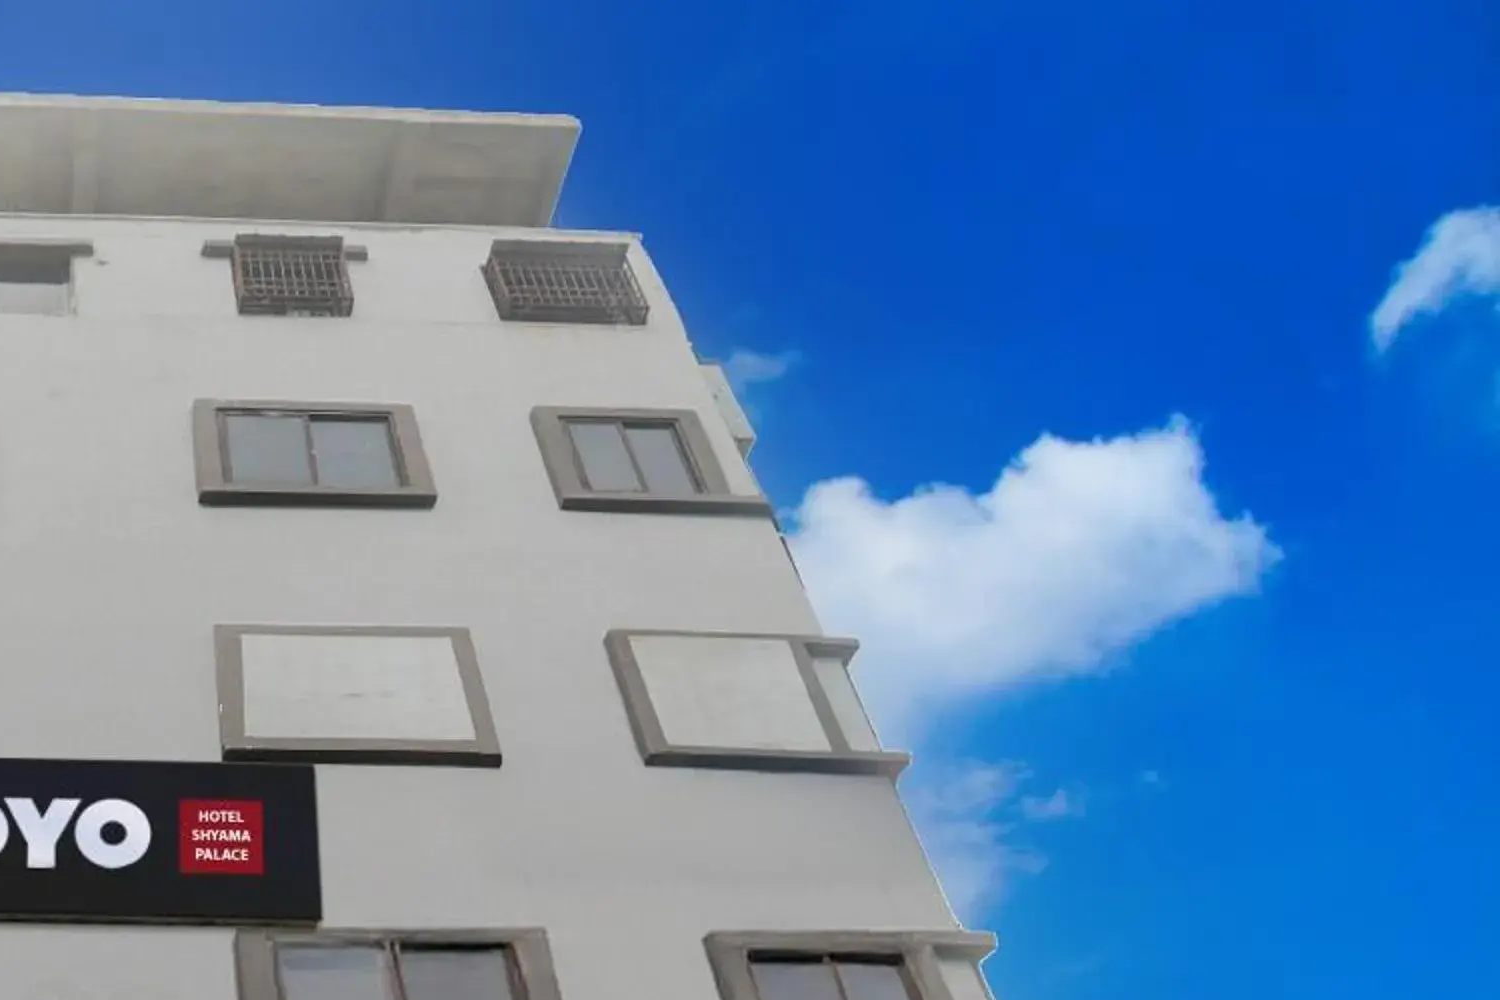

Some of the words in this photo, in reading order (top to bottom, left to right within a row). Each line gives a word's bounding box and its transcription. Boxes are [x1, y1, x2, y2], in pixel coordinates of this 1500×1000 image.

[199, 810, 244, 823] HOTEL
[192, 829, 251, 843] SHYAMA
[195, 848, 249, 861] PALACE
